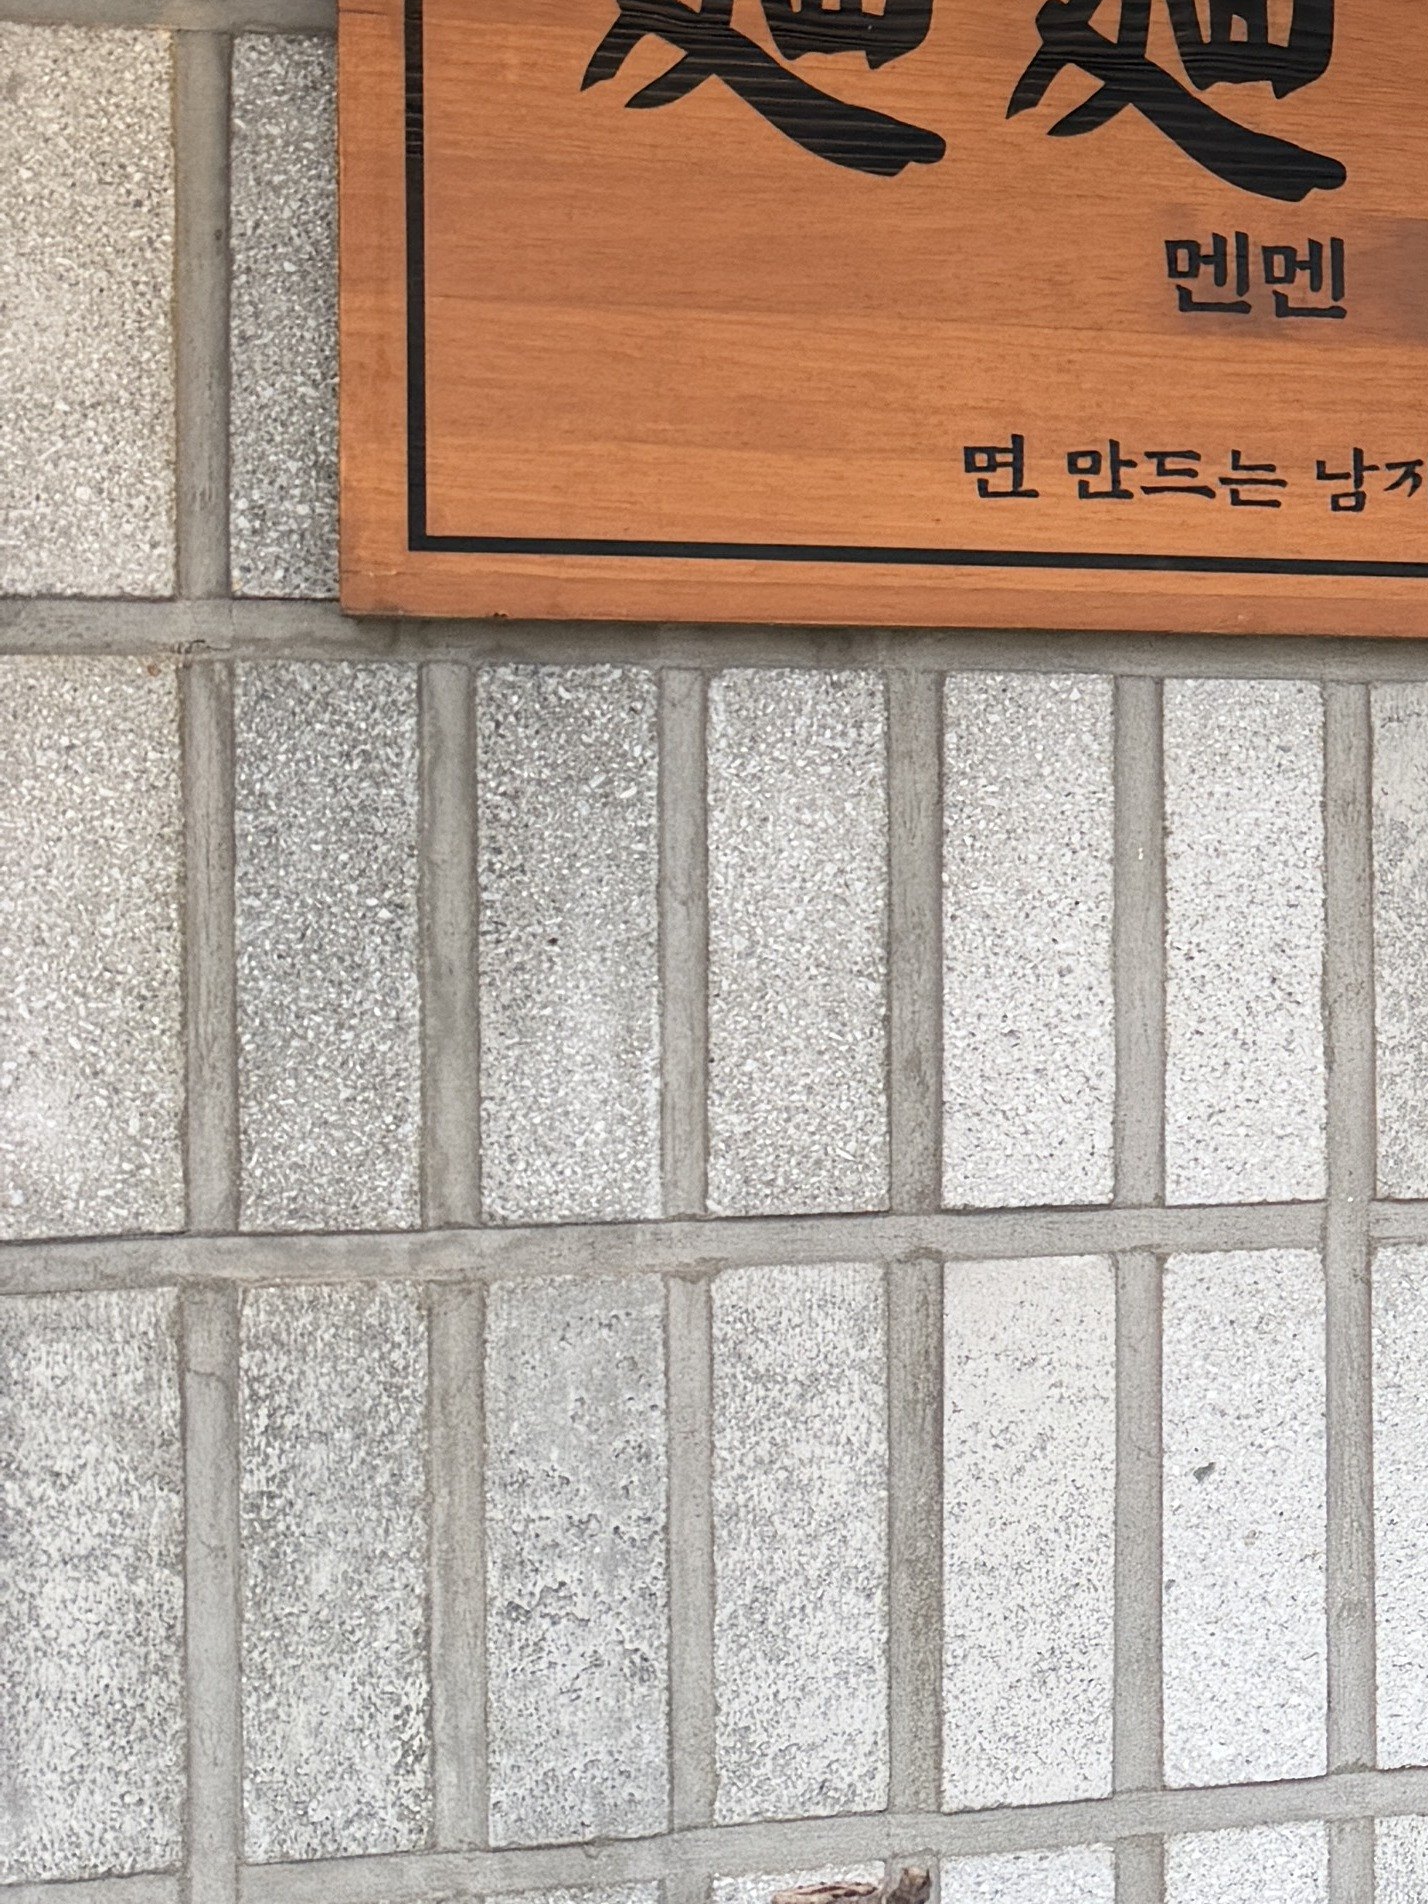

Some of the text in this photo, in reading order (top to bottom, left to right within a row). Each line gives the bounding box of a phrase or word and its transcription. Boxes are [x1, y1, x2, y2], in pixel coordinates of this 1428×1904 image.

[1164, 231, 1348, 320] 멘멘
[961, 433, 1038, 499] 면
[1066, 438, 1290, 509] 만드는
